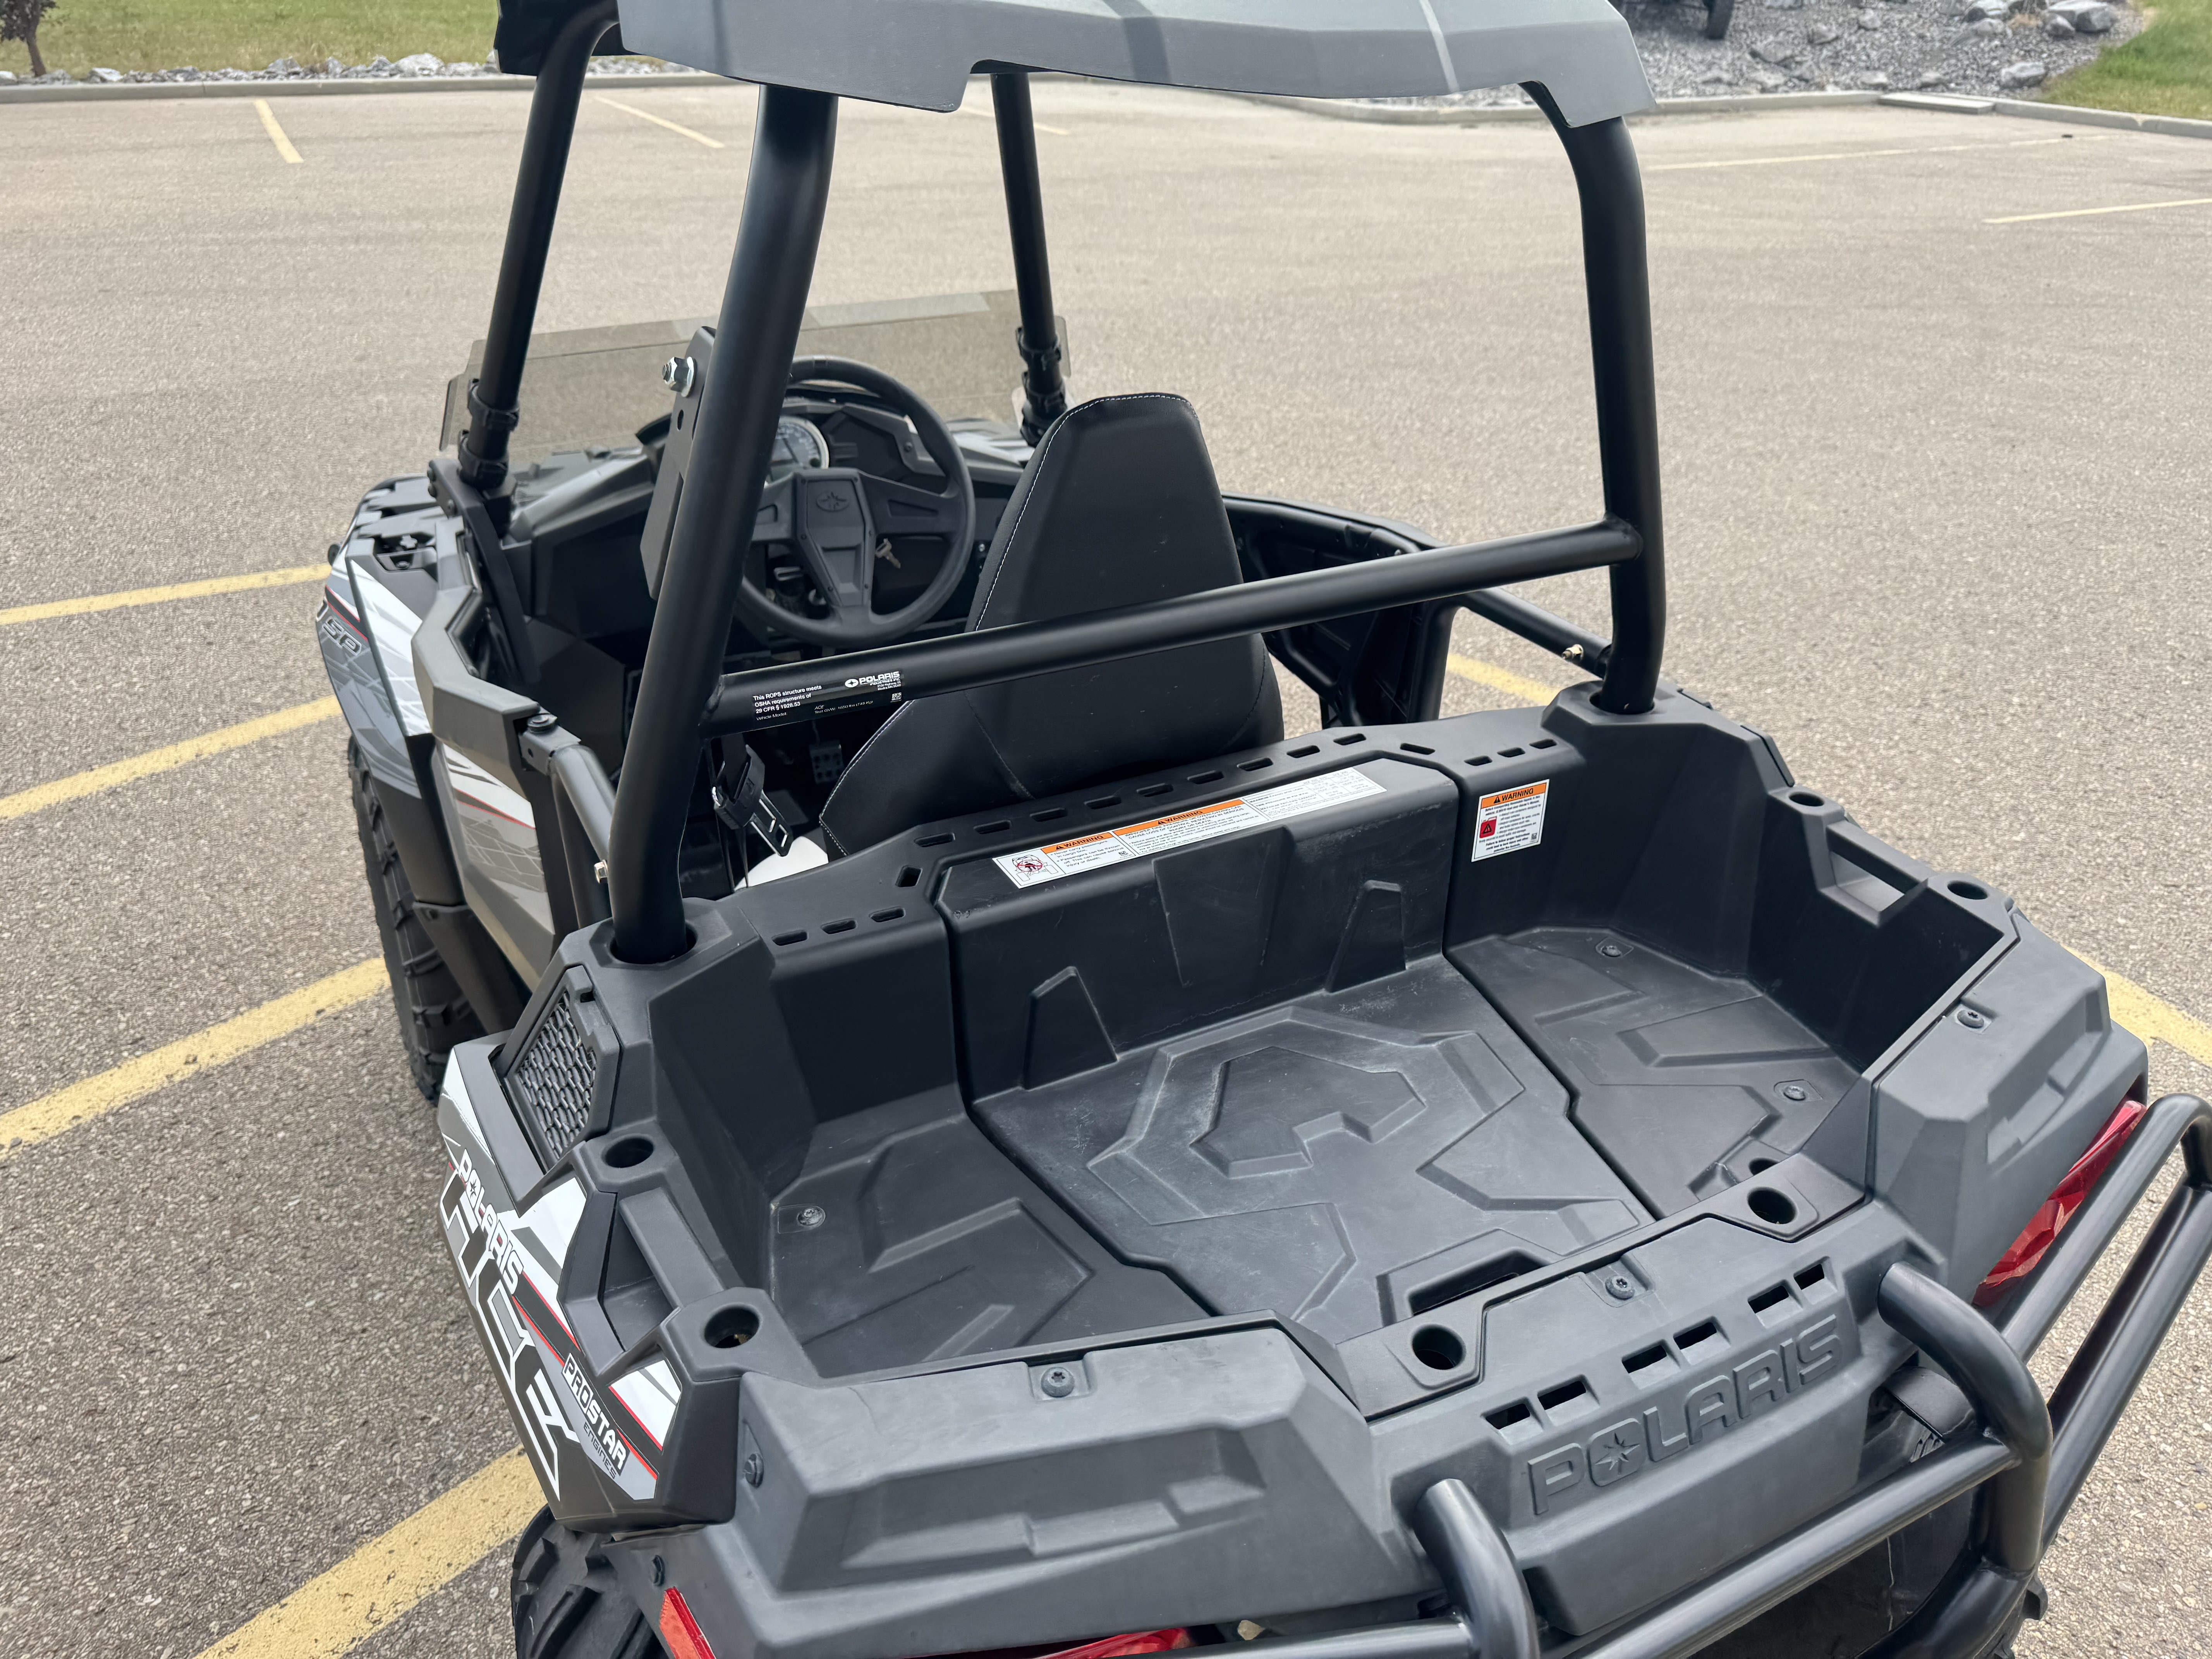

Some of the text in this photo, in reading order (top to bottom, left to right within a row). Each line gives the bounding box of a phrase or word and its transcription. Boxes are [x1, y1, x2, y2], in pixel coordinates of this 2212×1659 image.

[321, 616, 362, 656] SP
[859, 671, 900, 684] POLARIS
[772, 696, 805, 704] requirements
[1502, 788, 1533, 801] WARNING
[1165, 811, 1203, 822] WARNING
[1063, 835, 1104, 847] WARNING
[457, 1149, 524, 1295] POLARIS
[564, 1358, 627, 1470] PROSTAR
[1527, 1314, 1843, 1515] POLARIS
[583, 1422, 617, 1479] ENGINES
